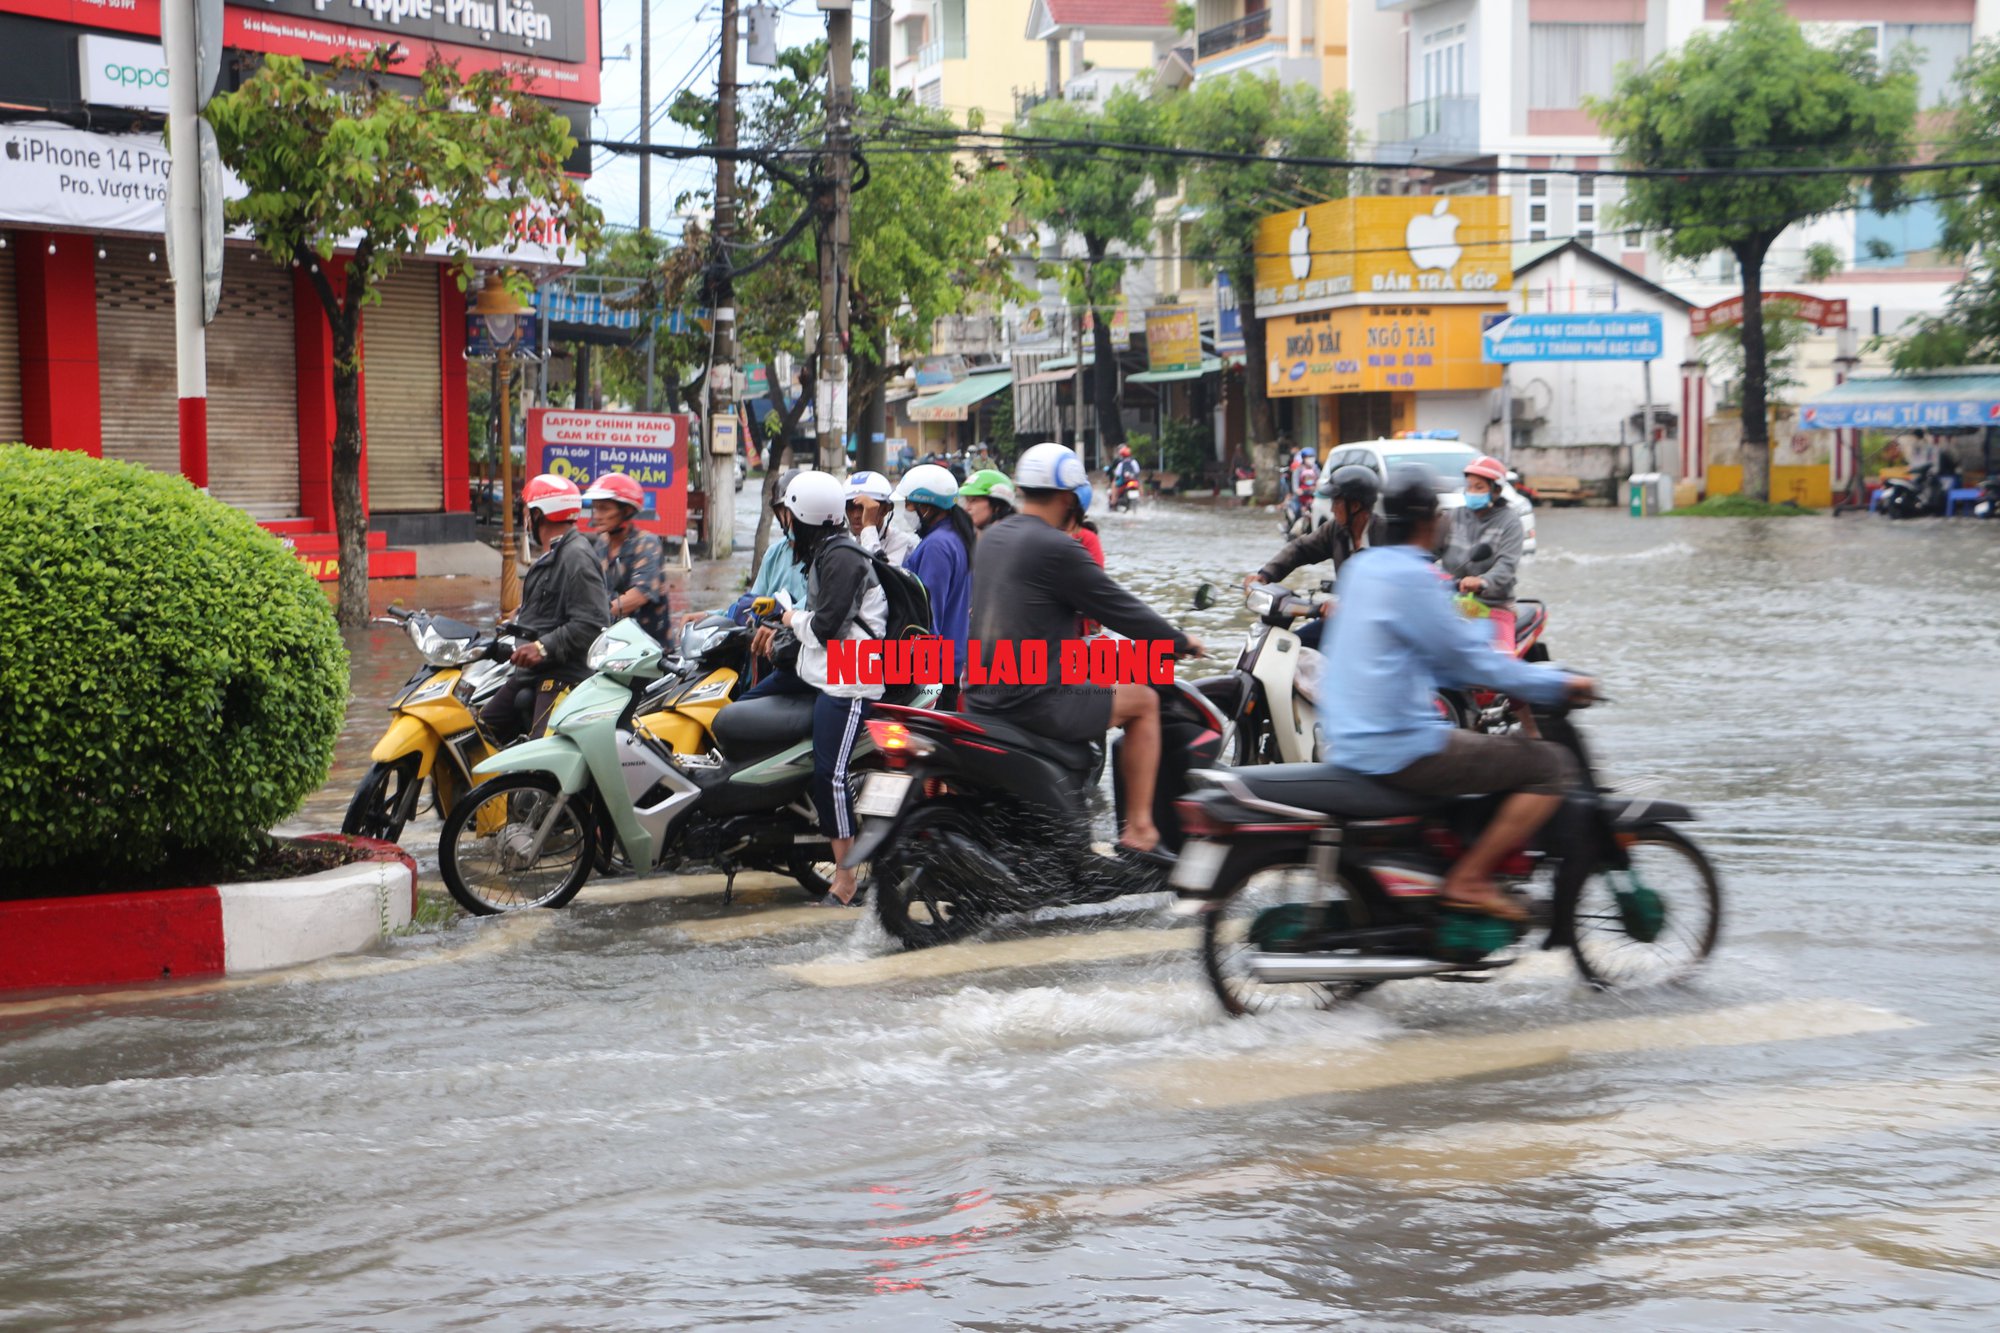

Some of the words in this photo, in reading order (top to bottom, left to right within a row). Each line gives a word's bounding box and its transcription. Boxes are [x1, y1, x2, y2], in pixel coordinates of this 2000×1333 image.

[498, 0, 552, 48] kiện
[104, 63, 170, 89] oppo
[23, 137, 100, 169] iPhone
[107, 148, 131, 172] 14
[60, 174, 94, 195] Pro.
[98, 178, 140, 203] Vượt
[144, 183, 167, 206] trộ
[546, 417, 591, 428] LAPTOP
[600, 447, 627, 461] BẢO
[630, 449, 667, 463] HÀNH
[549, 457, 590, 484] 0%
[629, 466, 666, 483] NĂM
